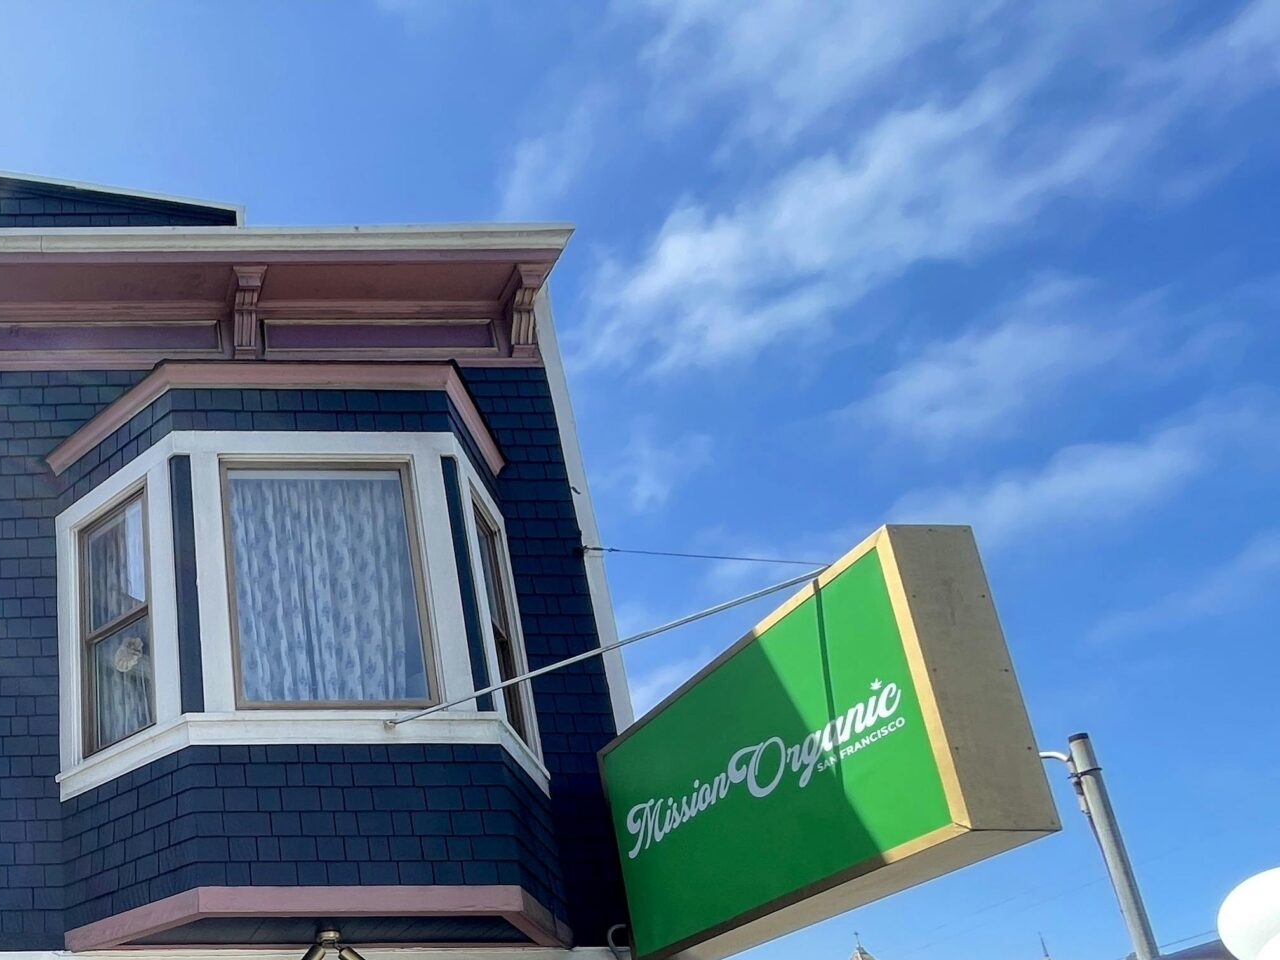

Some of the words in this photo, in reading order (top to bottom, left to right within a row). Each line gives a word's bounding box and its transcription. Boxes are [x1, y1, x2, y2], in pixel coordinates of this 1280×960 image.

[626, 772, 731, 859] Mission
[728, 679, 901, 798] Organic
[817, 755, 838, 772] SAN
[839, 716, 906, 760] FRANCISCO
